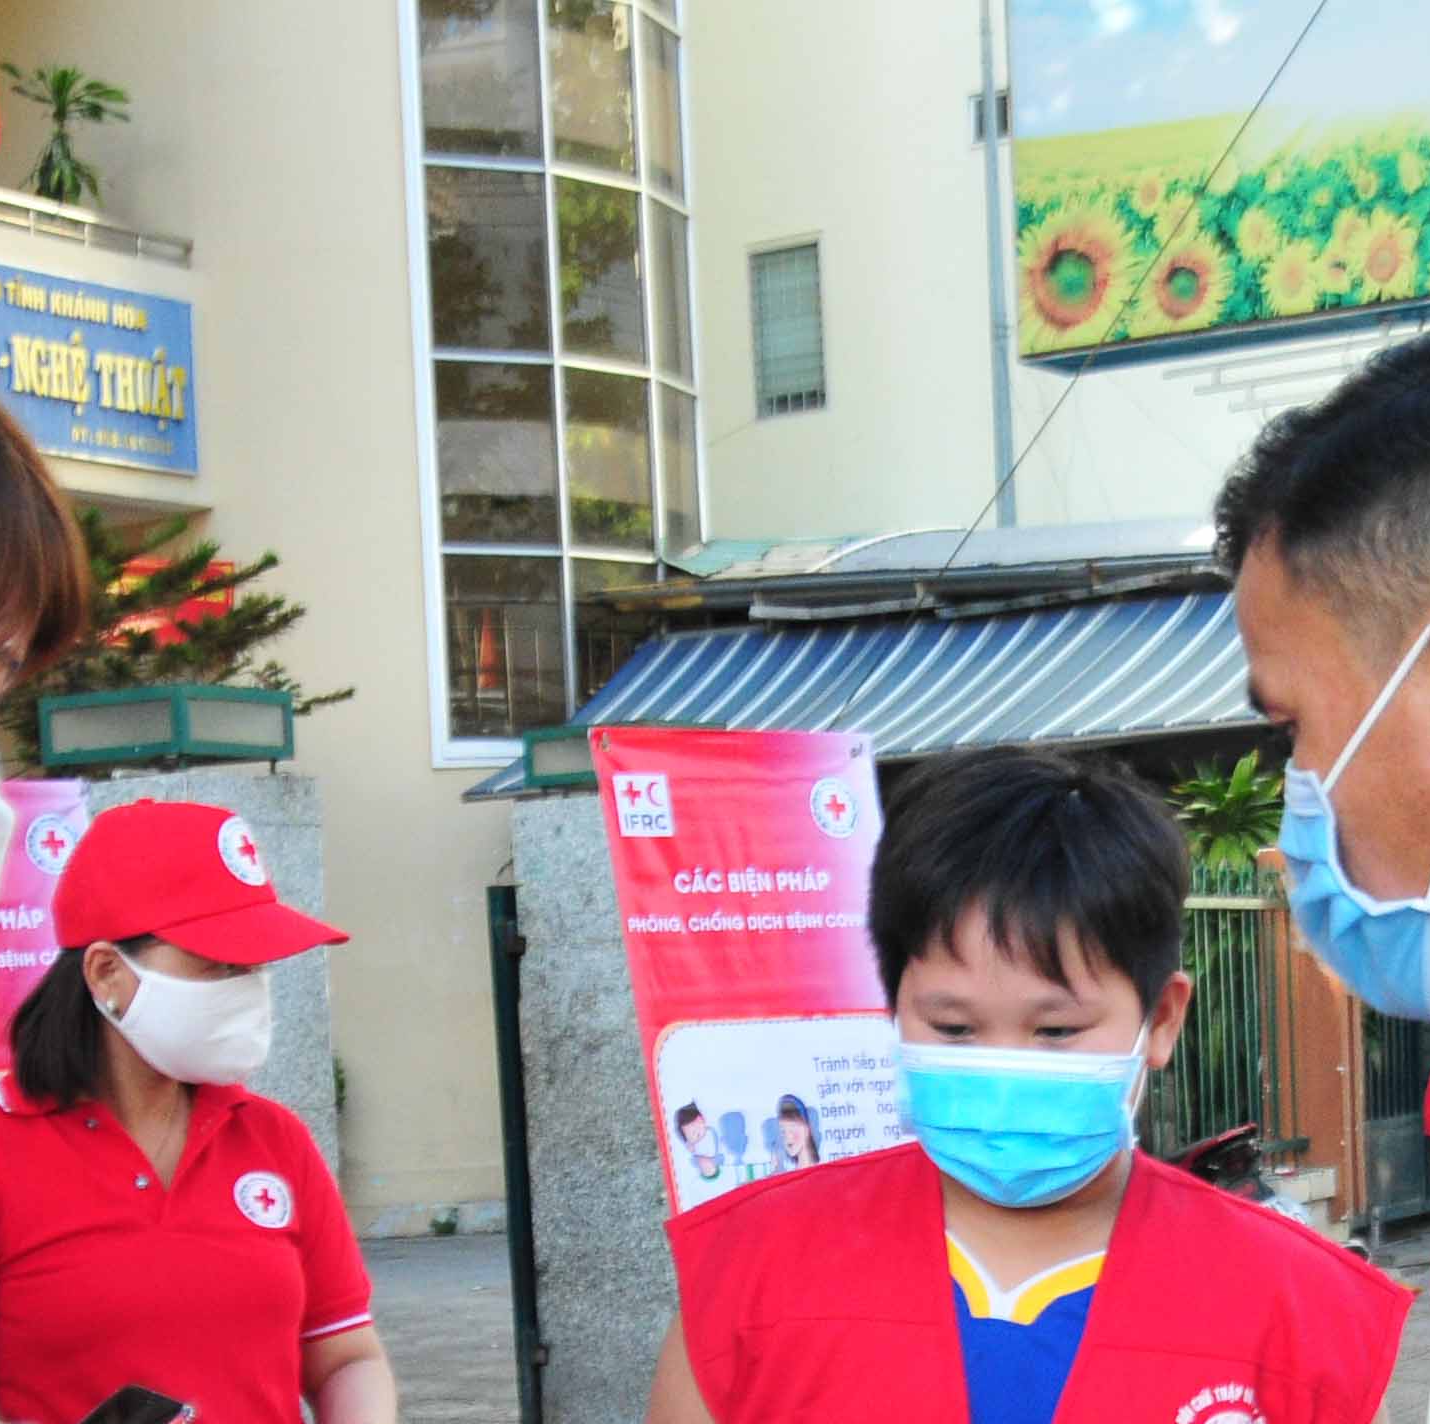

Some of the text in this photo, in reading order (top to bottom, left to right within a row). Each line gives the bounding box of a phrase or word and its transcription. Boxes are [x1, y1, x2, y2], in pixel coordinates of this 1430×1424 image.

[5, 274, 48, 313] TỈNH
[50, 287, 109, 325] KHÁNH
[94, 345, 188, 430] THUẬT
[624, 814, 668, 832] IFRC
[673, 866, 829, 897] CÁC BIỆN PHÁP
[688, 909, 745, 933] CHỐNG
[747, 914, 783, 934] DỊCH
[812, 1056, 850, 1072] Tránh
